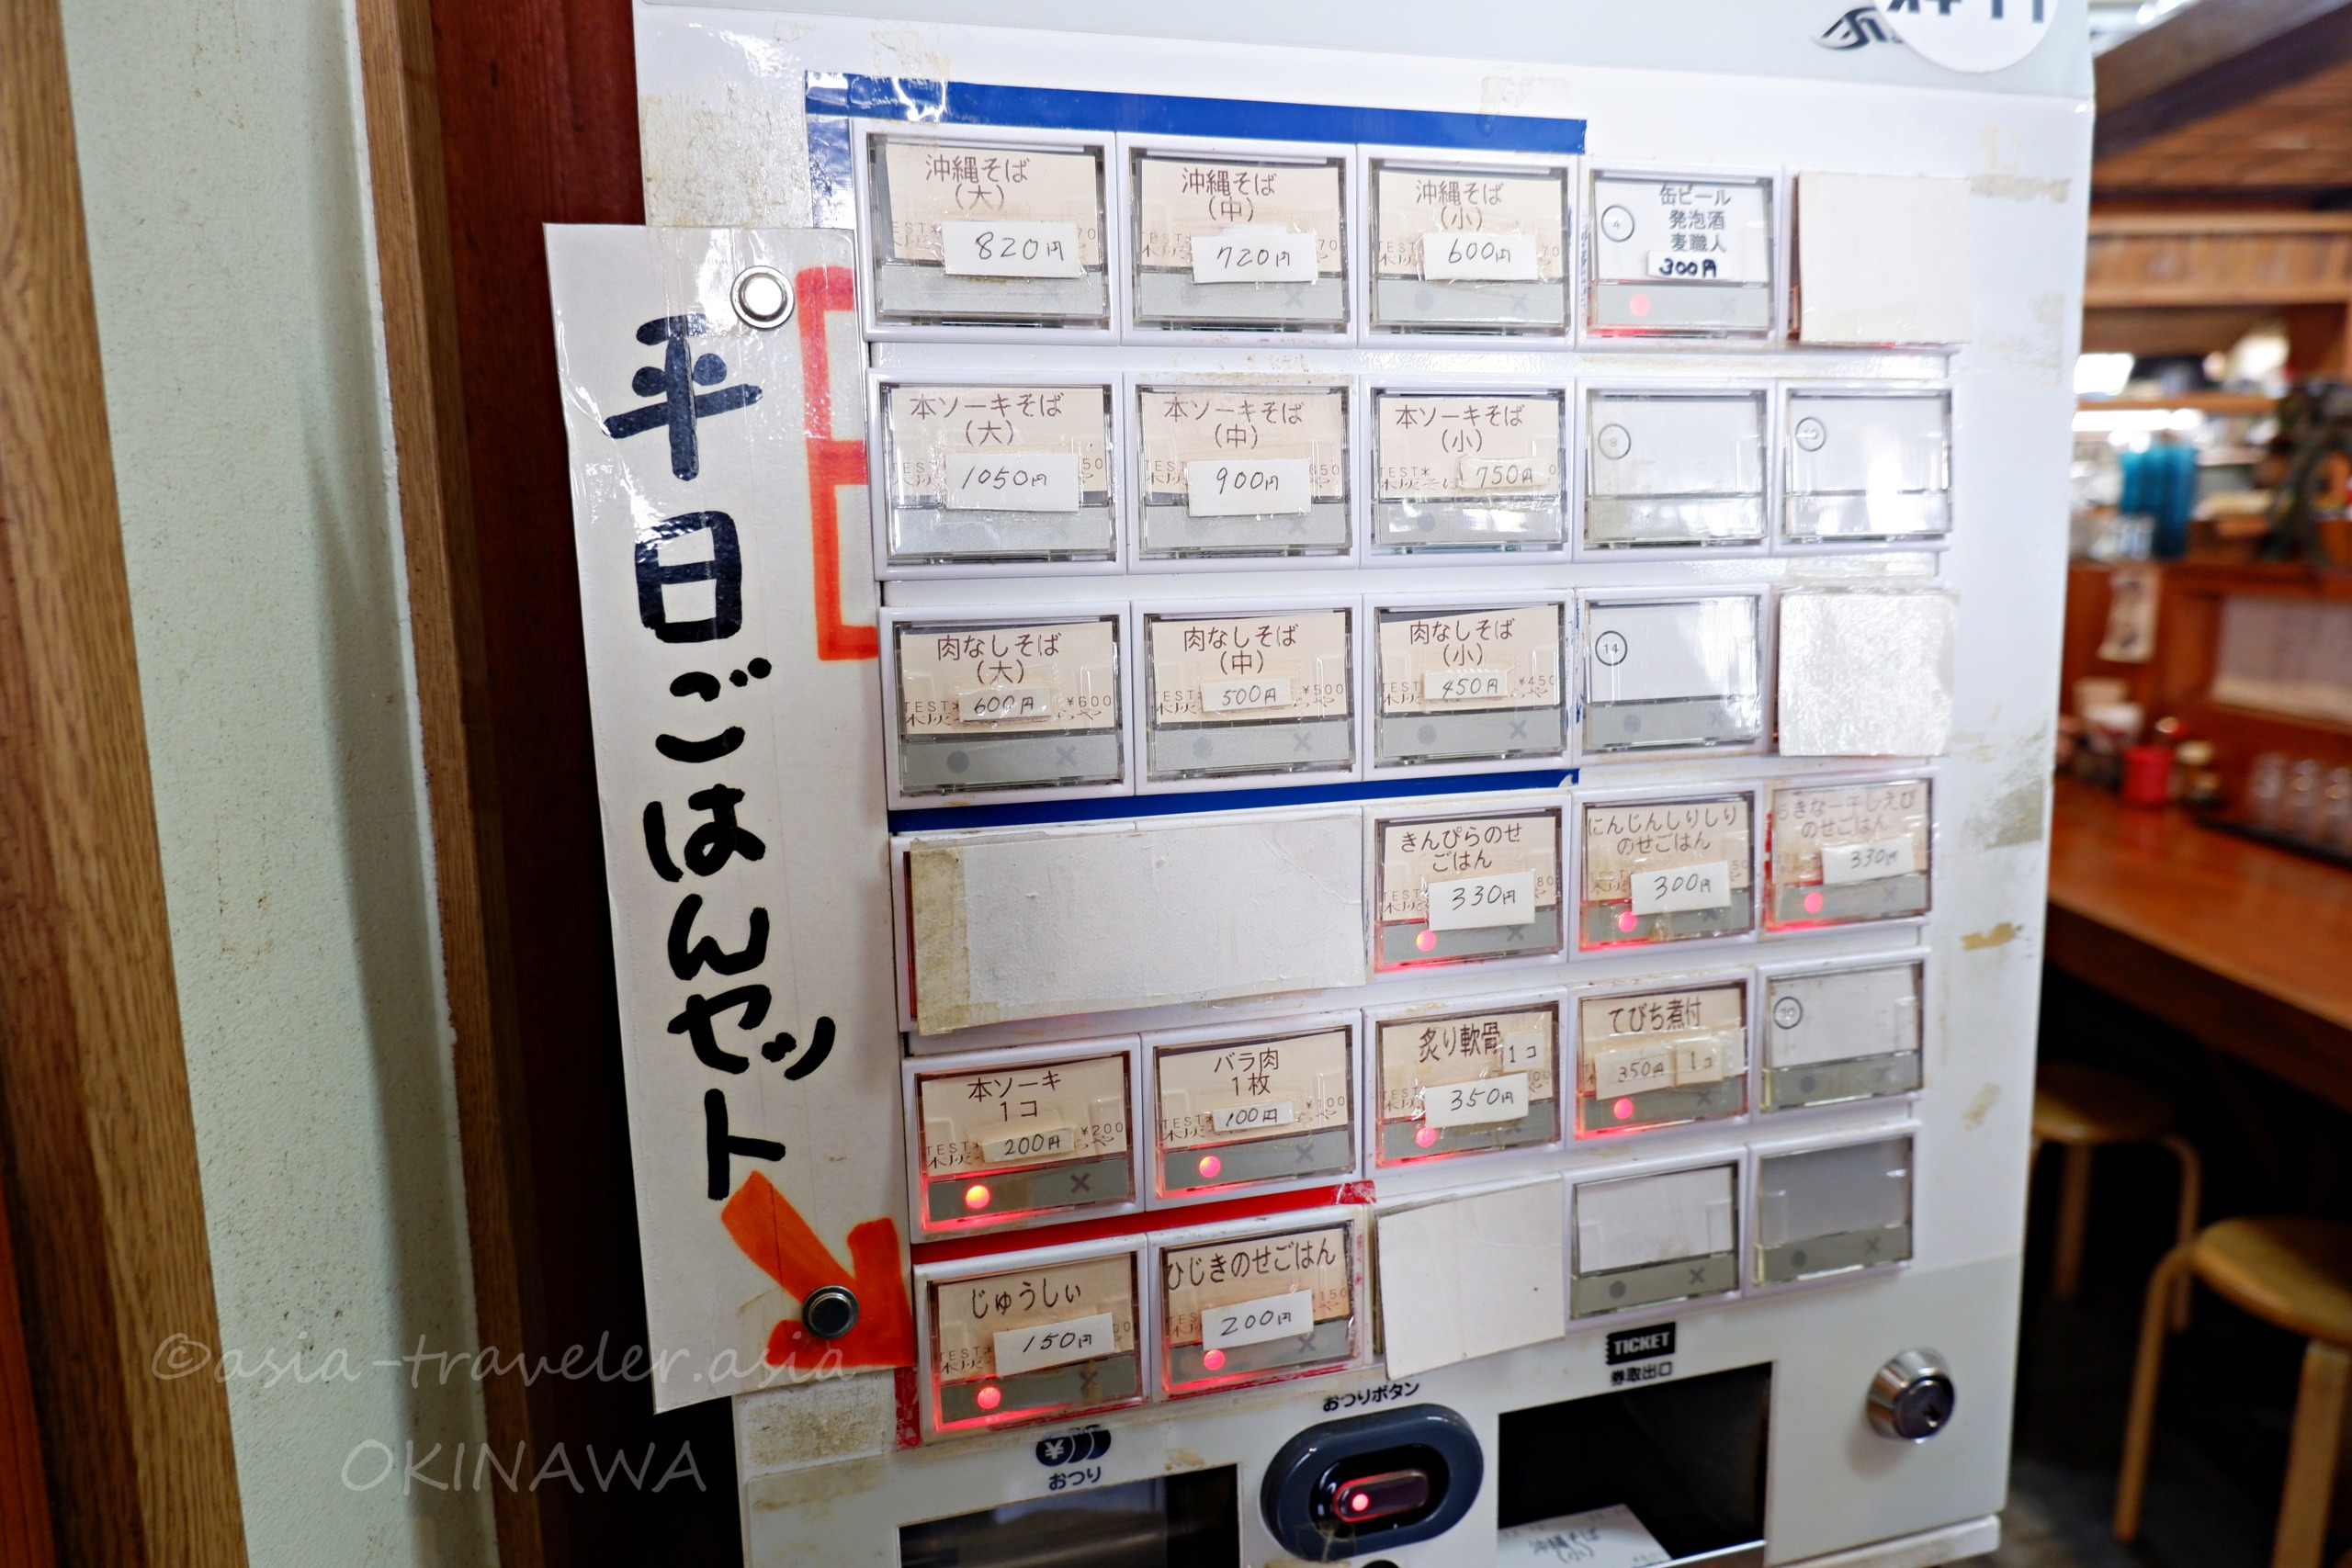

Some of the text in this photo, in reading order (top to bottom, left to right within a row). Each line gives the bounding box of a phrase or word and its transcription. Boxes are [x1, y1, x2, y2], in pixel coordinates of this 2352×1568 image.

[925, 154, 1030, 184] 沖縄そば
[1182, 167, 1277, 196] 沖縄そば
[956, 184, 1004, 209] (大)
[1416, 179, 1503, 206] 沖縄そば
[1659, 185, 1731, 206] 缶ビール
[1209, 196, 1254, 222] (中)
[1442, 206, 1483, 231] (小)
[1669, 210, 1724, 230] 発泡酒
[976, 231, 1064, 262] 820円
[1216, 246, 1290, 268] 720円
[1449, 238, 1510, 264] 600円
[1670, 234, 1727, 254] 麦職人
[1658, 258, 1717, 278] 300円
[910, 392, 1064, 420] 本ソーキそば
[1164, 397, 1305, 424] 本ソーキそば
[1396, 404, 1525, 430] 本ソーキそば
[966, 420, 1014, 446] (大)
[1215, 423, 1258, 449] (中)
[1442, 429, 1483, 453] (小)
[962, 466, 1046, 490] 1050円
[1217, 468, 1279, 494] 900円
[1476, 464, 1532, 488] 750円
[1184, 624, 1299, 652] 肉なしそば
[1410, 617, 1515, 645] 肉なしそば
[938, 632, 1062, 660] 肉なしそば
[1443, 643, 1483, 667] (小)
[977, 659, 1024, 685] (大)
[1220, 649, 1263, 675] (中)
[1067, 694, 1112, 707] ¥600
[1223, 684, 1276, 706] 500円
[1303, 683, 1344, 696] ¥500
[1442, 678, 1498, 699] 450円
[974, 695, 1034, 715] 600円
[603, 314, 836, 1201] 平日ごはんセット
[1588, 806, 1736, 837] にんじんしりしり
[1401, 822, 1522, 852] きんぴらのせ
[1617, 831, 1711, 855] のせごはん
[1432, 850, 1492, 873] ごはん
[1453, 885, 1515, 910] 330円
[1654, 874, 1711, 900] 300円
[1609, 996, 1702, 1033] てびち煮付
[1419, 1021, 1500, 1063] 炙り軟骨
[1214, 1047, 1279, 1073] バラ肉
[1618, 1061, 1664, 1083] 350円
[967, 1071, 1061, 1102] 本ソーキ
[1231, 1072, 1271, 1096] 1枚
[1451, 1089, 1513, 1111] 350円
[1080, 1122, 1124, 1136] ¥200
[1226, 1108, 1277, 1127] 100円
[1004, 1134, 1059, 1156] 200円
[1167, 1237, 1336, 1291] ひじきのせごはん
[972, 1278, 1081, 1319] じゅうしい
[1220, 1310, 1292, 1337] 200円
[1023, 1332, 1091, 1353] 150円
[1613, 1331, 1670, 1356] TICKET
[1323, 1382, 1419, 1412] おつりボタン
[1048, 1466, 1101, 1491] おつり
